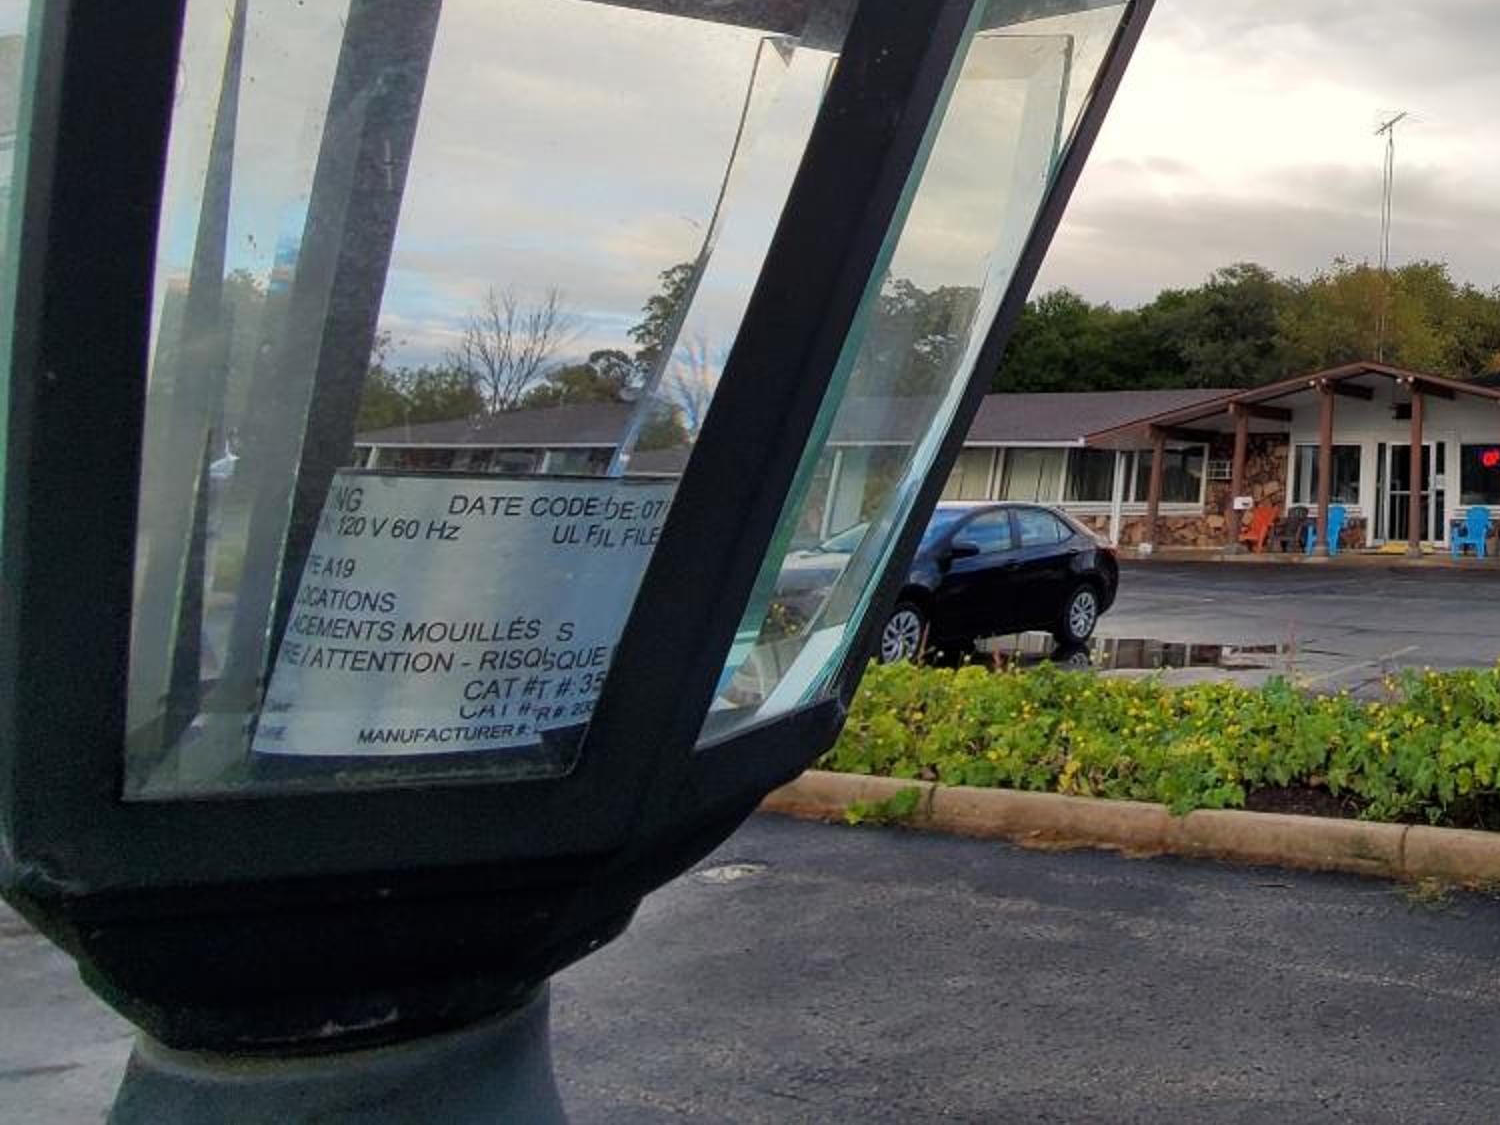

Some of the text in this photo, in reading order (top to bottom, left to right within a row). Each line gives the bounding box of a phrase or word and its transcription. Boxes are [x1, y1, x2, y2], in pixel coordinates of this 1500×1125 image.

[449, 494, 523, 517] DATE
[337, 515, 367, 537] 120
[372, 517, 389, 537] V
[391, 519, 420, 538] 60
[426, 520, 461, 540] Hz
[551, 525, 580, 544] UL
[321, 558, 355, 577] A19
[401, 616, 540, 642] MOUILLÉS
[555, 622, 575, 642] S
[463, 677, 519, 700] CAT
[357, 724, 513, 744] MANUFACTURER
